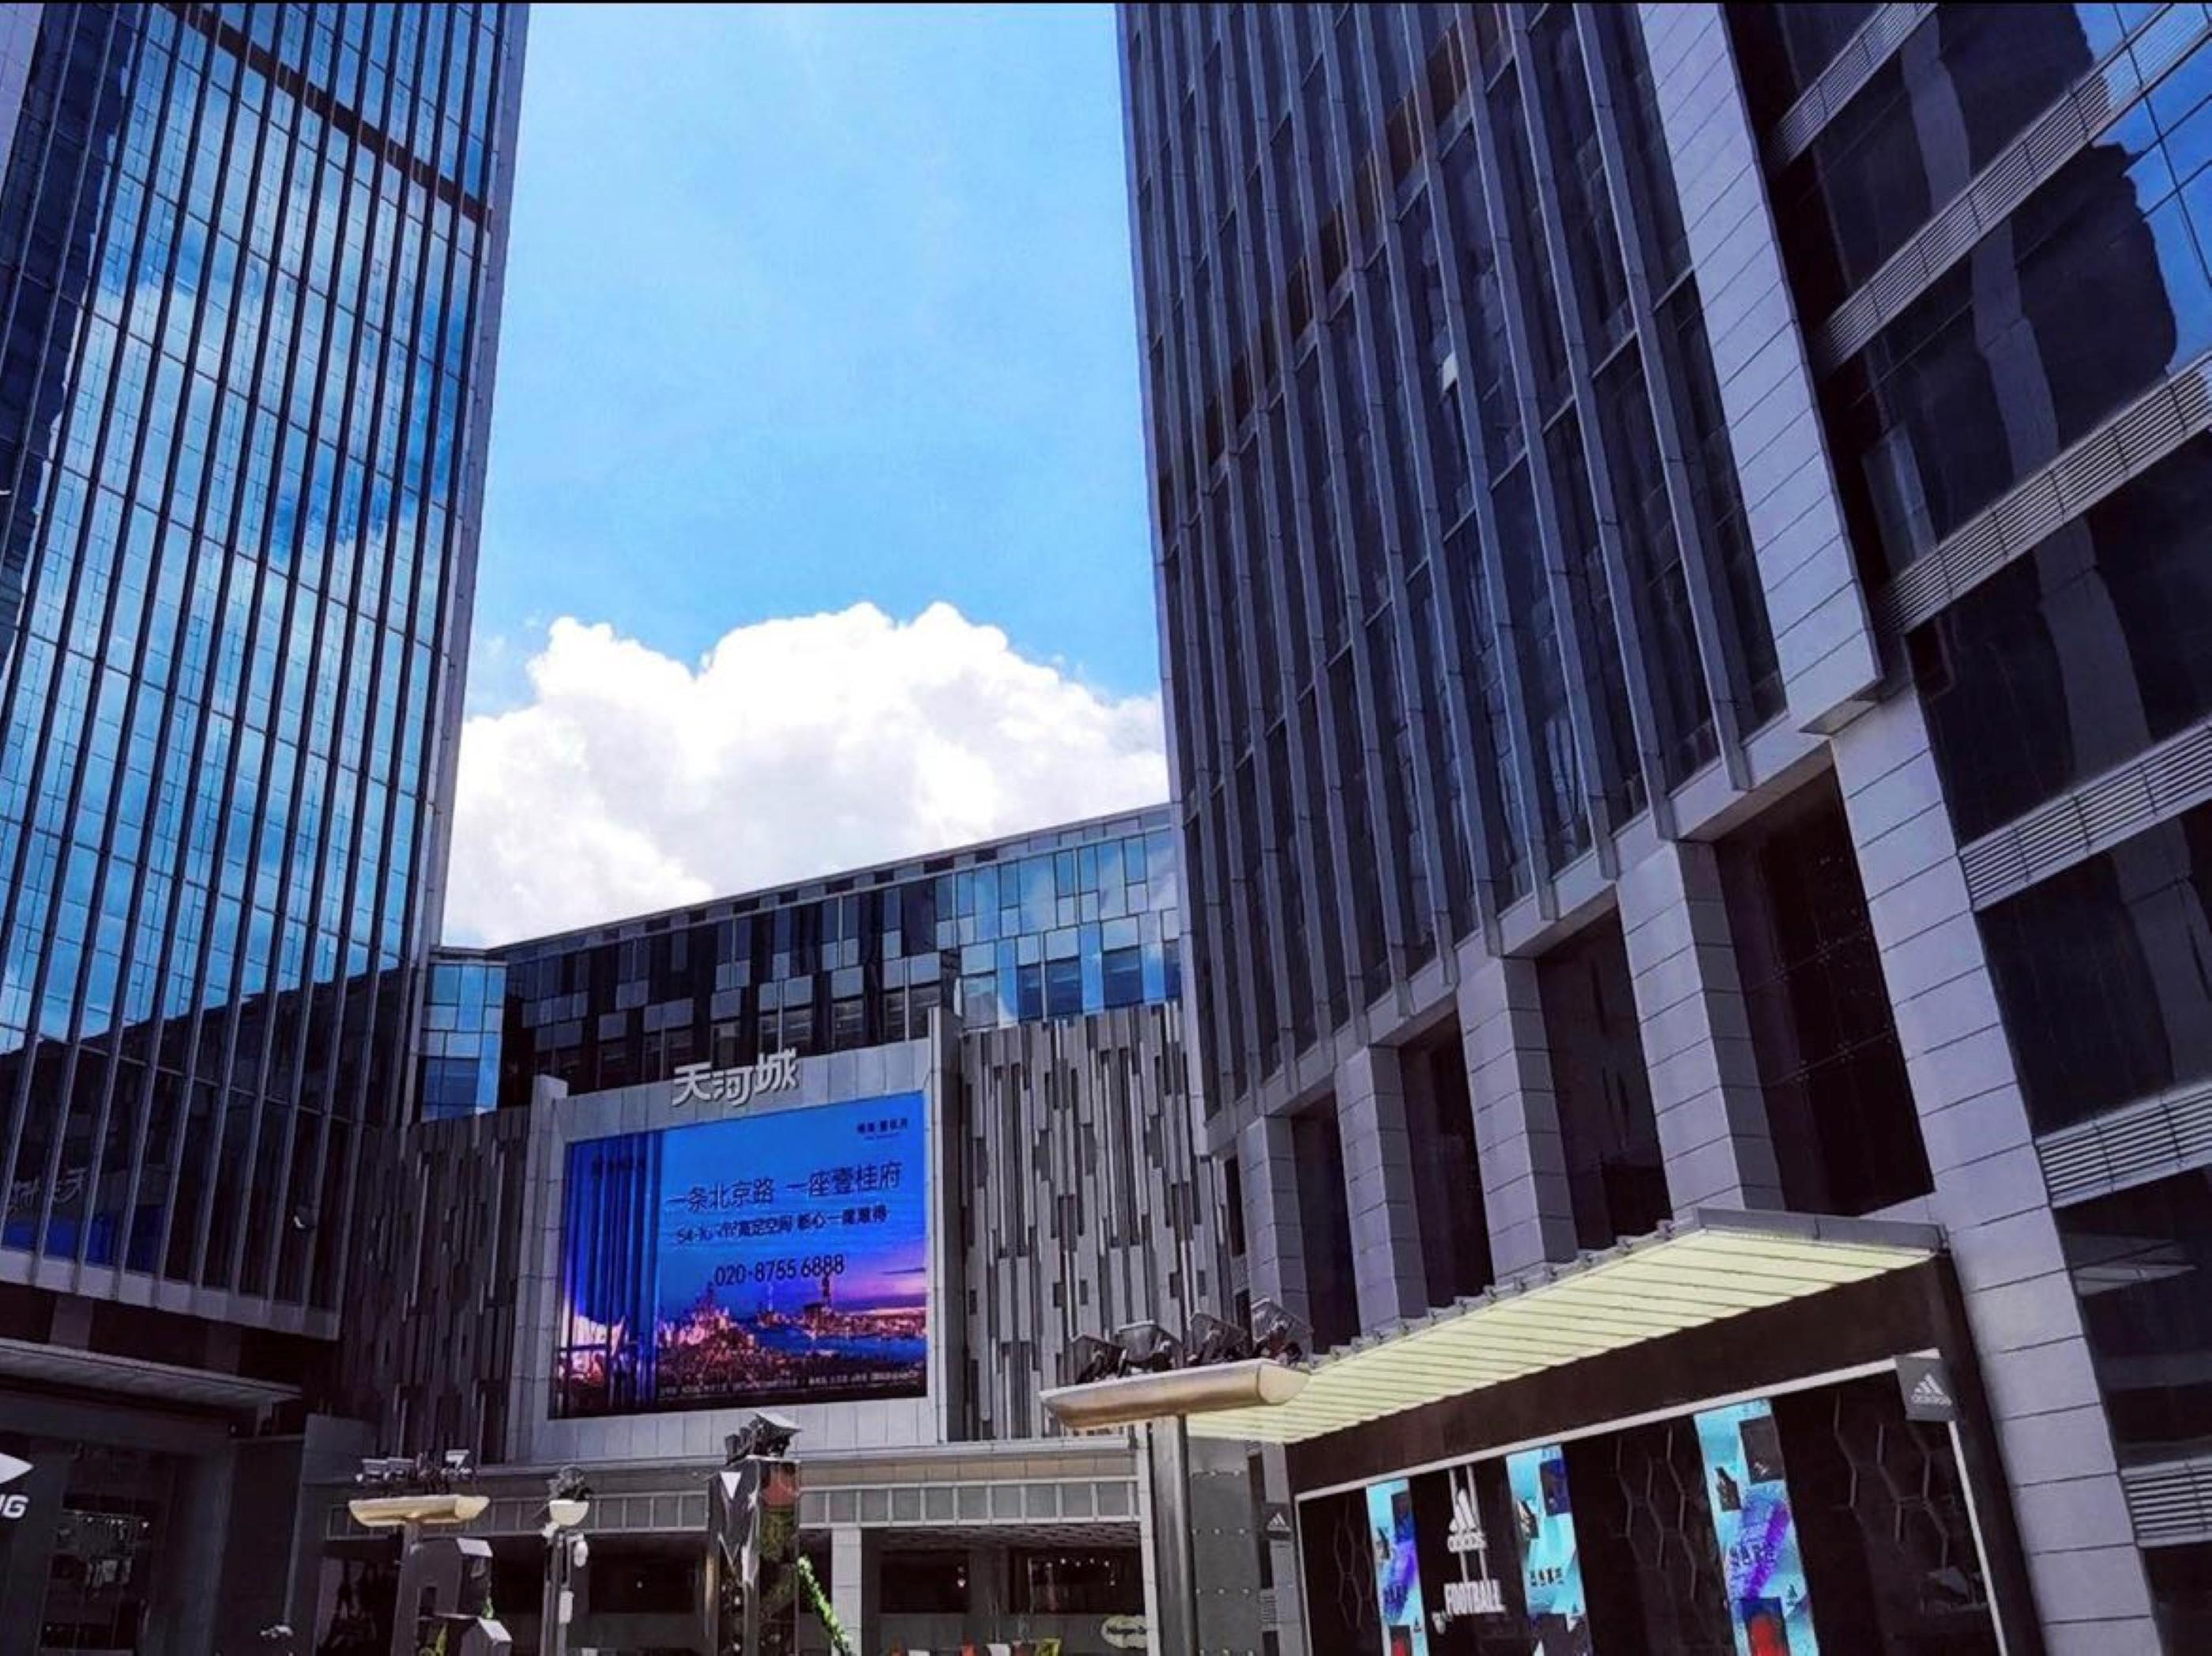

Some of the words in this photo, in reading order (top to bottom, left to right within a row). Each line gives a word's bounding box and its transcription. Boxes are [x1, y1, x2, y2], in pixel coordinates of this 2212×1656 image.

[672, 1048, 798, 1106] 天河城
[668, 1178, 774, 1211] 一条北京路
[1443, 1579, 1507, 1615] FOOTBALL
